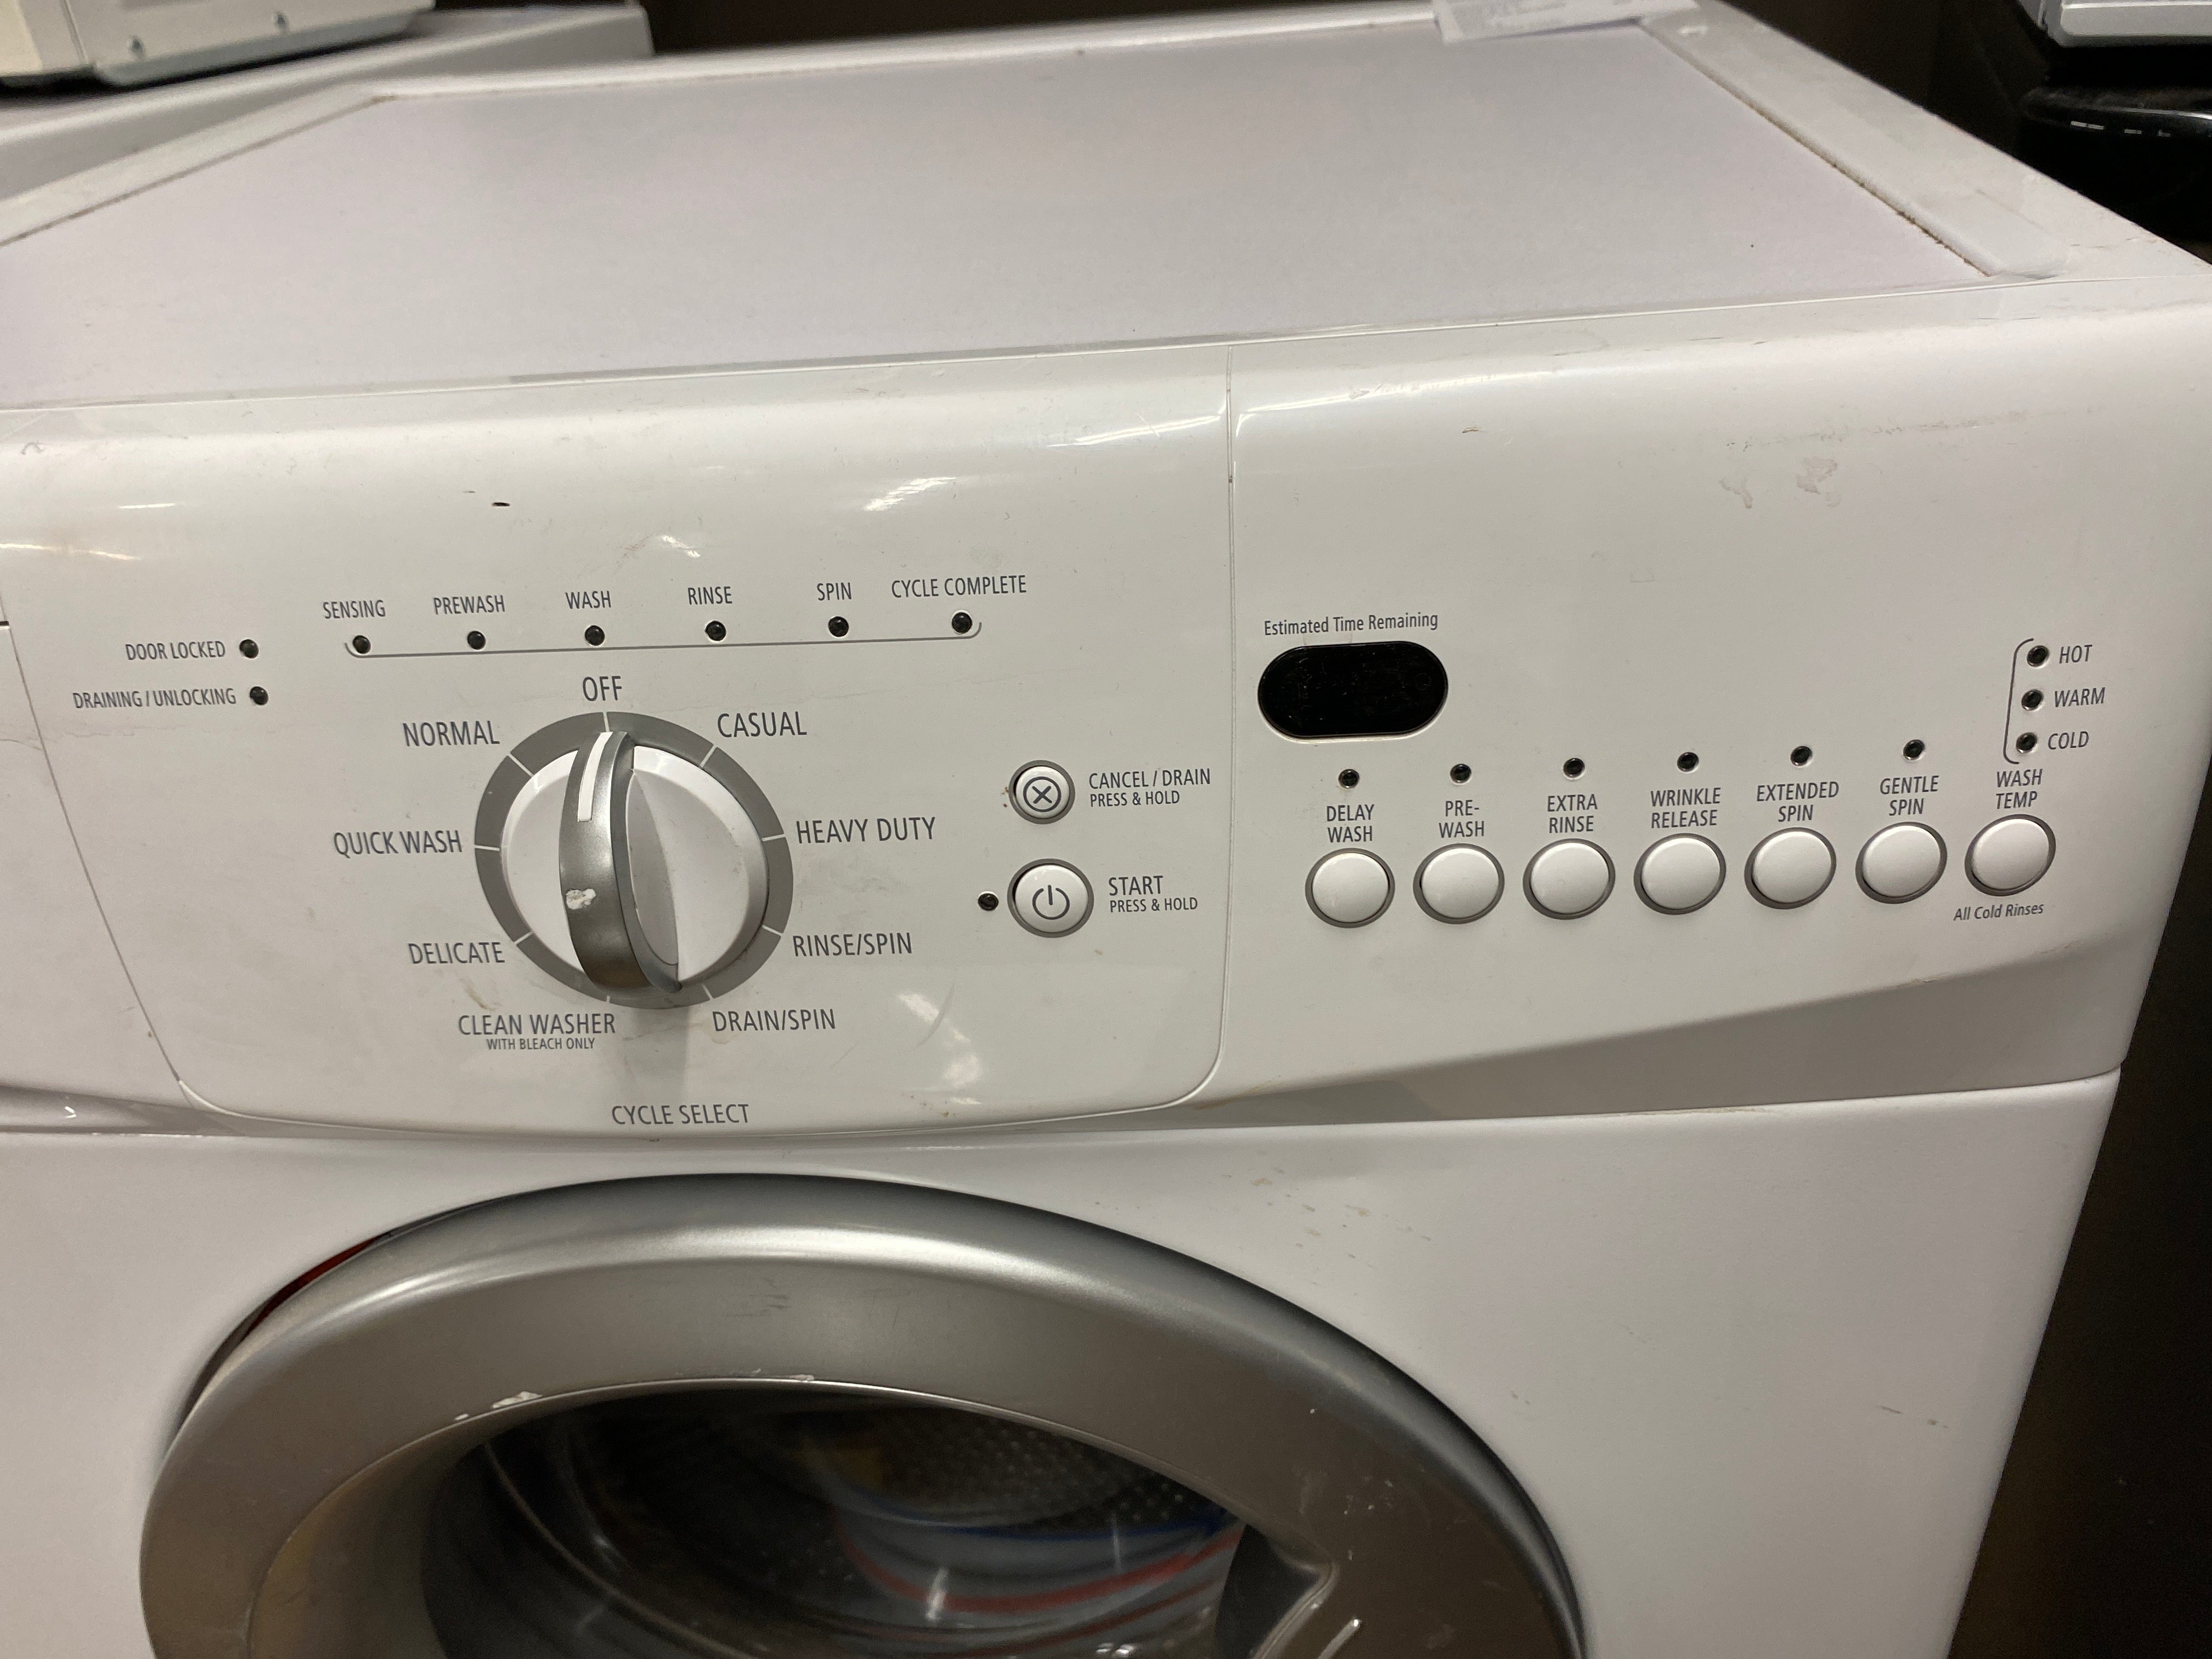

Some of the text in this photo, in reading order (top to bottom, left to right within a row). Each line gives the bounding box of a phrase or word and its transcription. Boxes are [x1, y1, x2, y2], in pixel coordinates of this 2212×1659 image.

[687, 585, 733, 606] RINSE
[816, 582, 852, 601] SPIN
[891, 574, 1027, 599] CYCLE COMPLETE
[323, 599, 386, 619] SENSING
[432, 594, 505, 616] PREWASH
[564, 590, 612, 610] WASH
[1264, 612, 1438, 636] Estimated Time Remaining
[125, 640, 226, 661] DOOR LOCKED
[2058, 644, 2093, 664] HOT
[72, 690, 143, 709] DRAINING
[152, 687, 237, 707] UNLOCKING
[582, 675, 623, 702] OFF
[2054, 686, 2106, 708] WARM
[402, 720, 501, 747] NORMAL
[717, 710, 808, 738] CASUAL
[2047, 731, 2090, 751] COLD
[1088, 771, 1149, 789] CANCEL
[1162, 768, 1211, 787] DRAIN
[1880, 775, 1939, 795] GENTLE
[1996, 768, 2043, 788] WASH
[1090, 790, 1180, 808] PRESS & HOLD
[1650, 787, 1722, 807] WRINKLE
[1756, 781, 1839, 802] EXTENDED
[1995, 791, 2038, 810] TEMP
[1445, 799, 1480, 817] PRE-
[1547, 793, 1598, 812] EXTRA
[1888, 798, 1925, 816] SPIN
[1326, 804, 1375, 822] DELAY
[1651, 809, 1718, 829] RELEASE
[1778, 804, 1814, 823] SPIN
[795, 816, 936, 844] HEAVY DUTY
[1327, 825, 1373, 843] WASH
[1438, 820, 1485, 839] WASH
[1549, 815, 1594, 834] RINSE
[333, 830, 463, 859] QUICK WASH
[1108, 875, 1164, 896] START
[1110, 896, 1198, 913] PRESS & HOLD
[1953, 904, 2044, 921] All Cold Rinses
[408, 941, 505, 964] DELICATE
[792, 932, 912, 957] RINSE/SPIN
[458, 1013, 616, 1036] CLEAN WASHER
[712, 1008, 836, 1032] DRAIN/SPIN
[486, 1037, 595, 1050] WITH BLEACH ONLY
[612, 1103, 749, 1125] CYCLE SELECT
